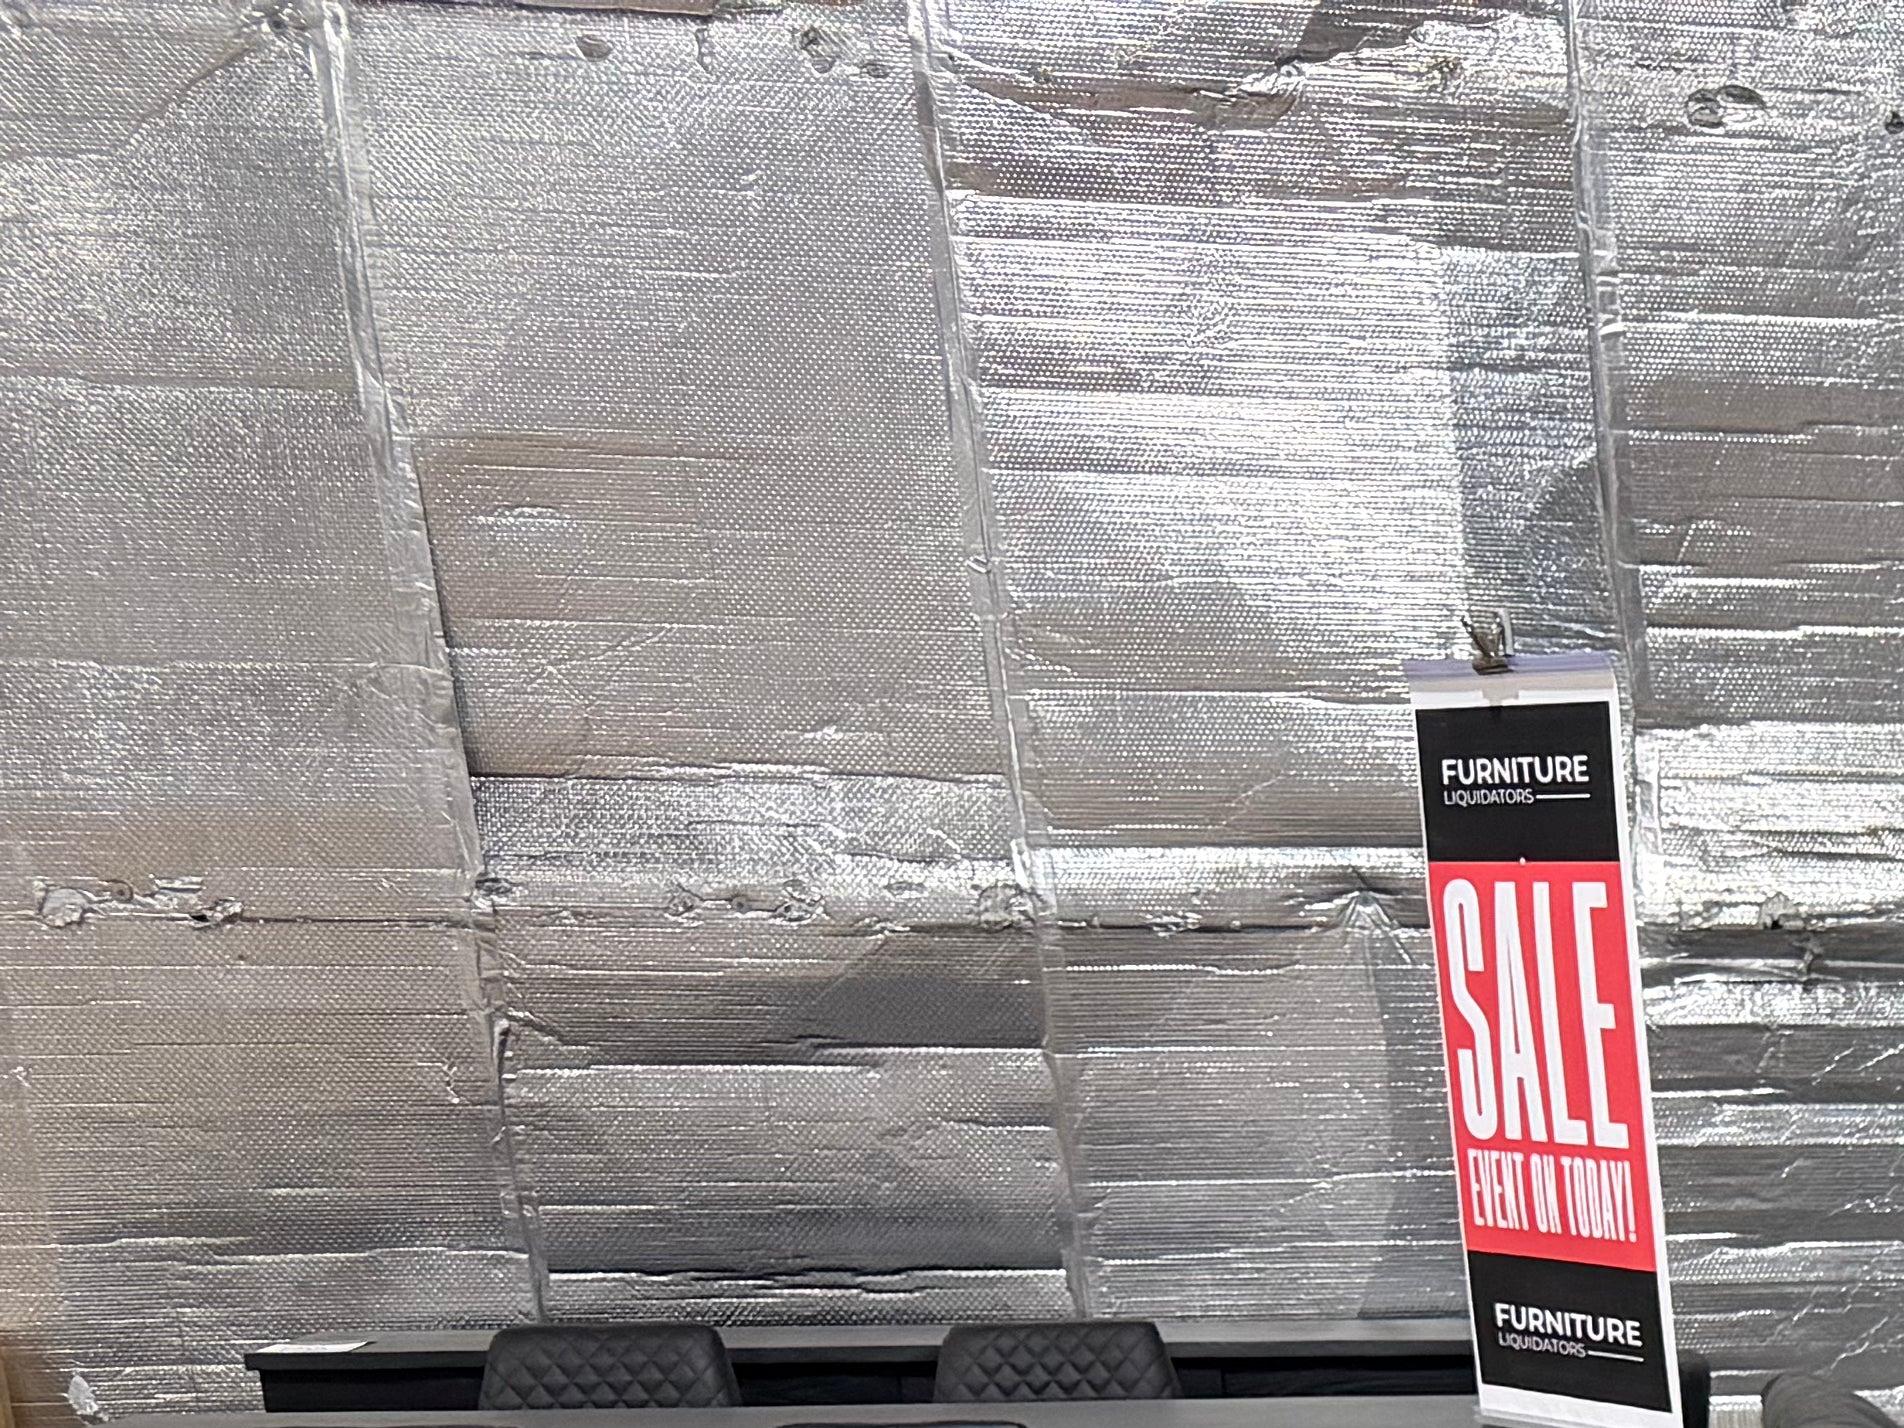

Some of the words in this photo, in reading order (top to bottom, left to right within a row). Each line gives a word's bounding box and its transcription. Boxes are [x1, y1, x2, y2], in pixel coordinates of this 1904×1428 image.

[1441, 755, 1590, 785] FURNITURE
[1443, 788, 1535, 808] LIQUIDATORS
[1442, 878, 1630, 1149] SALE
[1467, 1148, 1530, 1231] EVENT
[1530, 1154, 1562, 1235] ON
[1560, 1156, 1637, 1243] TODAY!
[1494, 1302, 1643, 1348] FURNITURE
[1498, 1332, 1587, 1358] LIQUIDATORS
